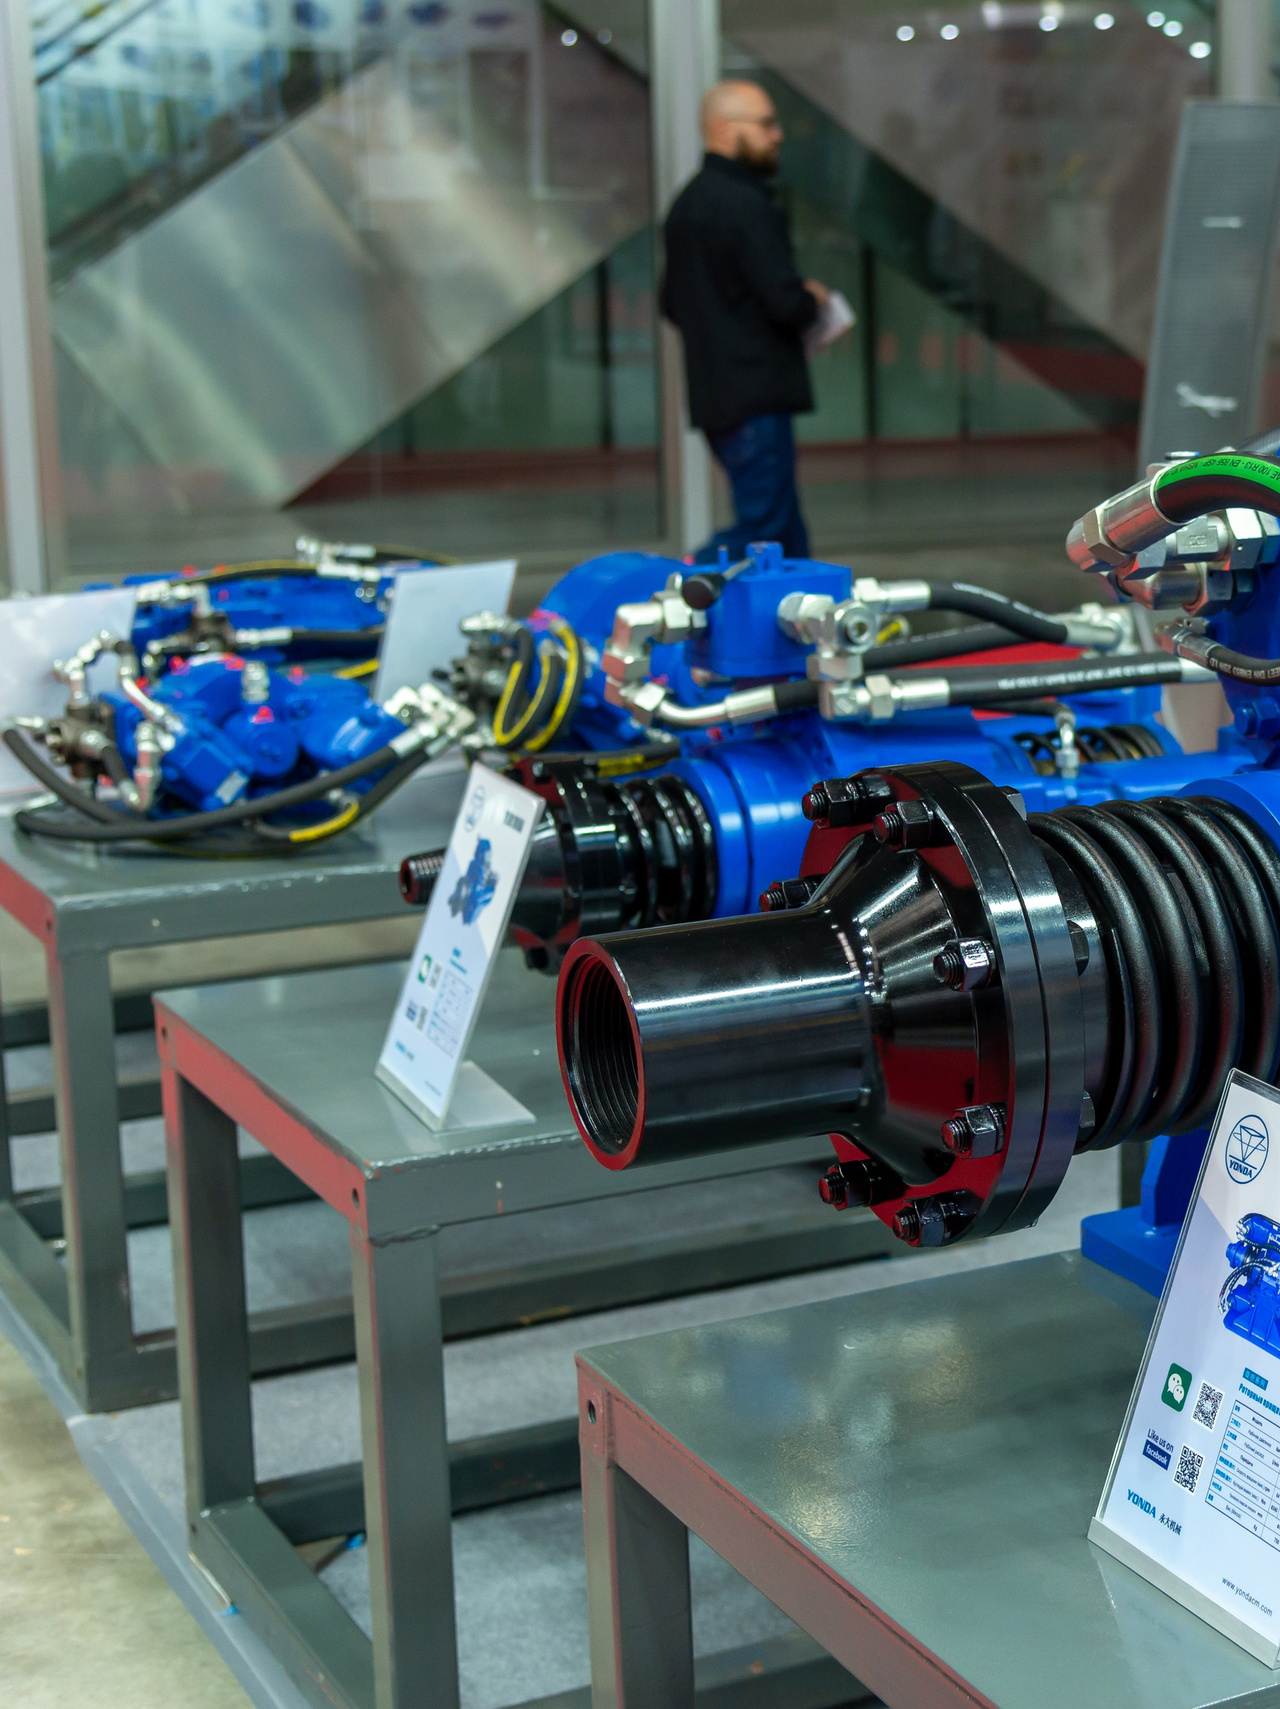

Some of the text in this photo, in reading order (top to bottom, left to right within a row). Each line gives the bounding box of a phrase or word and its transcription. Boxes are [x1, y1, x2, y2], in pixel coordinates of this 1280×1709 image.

[1228, 459, 1242, 468] EN
[1244, 462, 1260, 471] R13
[1258, 465, 1272, 476] 100
[1253, 670, 1265, 680] DIN
[1229, 1159, 1252, 1178] YONDA
[1148, 1428, 1174, 1453] Like us on
[1146, 1444, 1168, 1466] facebook
[1127, 1488, 1156, 1518] YONDA
[1159, 1513, 1182, 1536] 永大机械
[1222, 1577, 1272, 1616] www.yondacm.com
